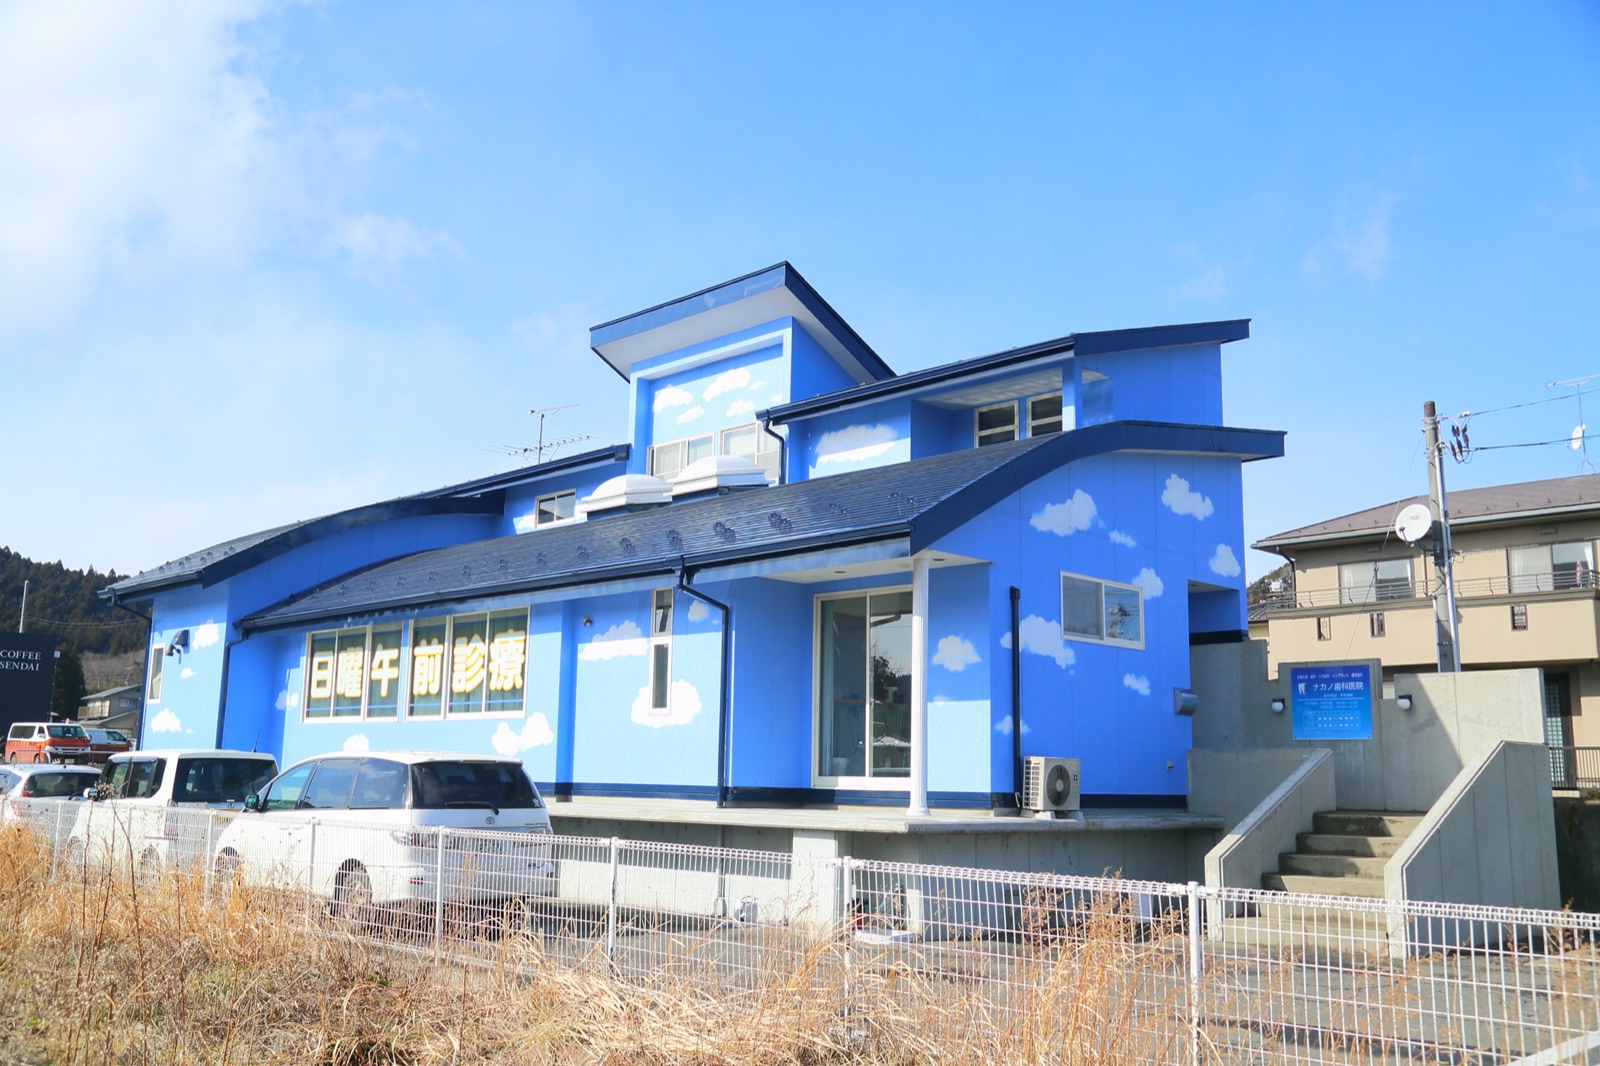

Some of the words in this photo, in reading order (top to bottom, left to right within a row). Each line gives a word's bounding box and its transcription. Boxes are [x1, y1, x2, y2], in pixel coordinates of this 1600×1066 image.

[0, 650, 41, 660] COFFEE
[0, 661, 40, 671] SENDAI
[310, 628, 526, 699] 日曜午前診療
[1312, 681, 1364, 692] ナカノ歯科医院
